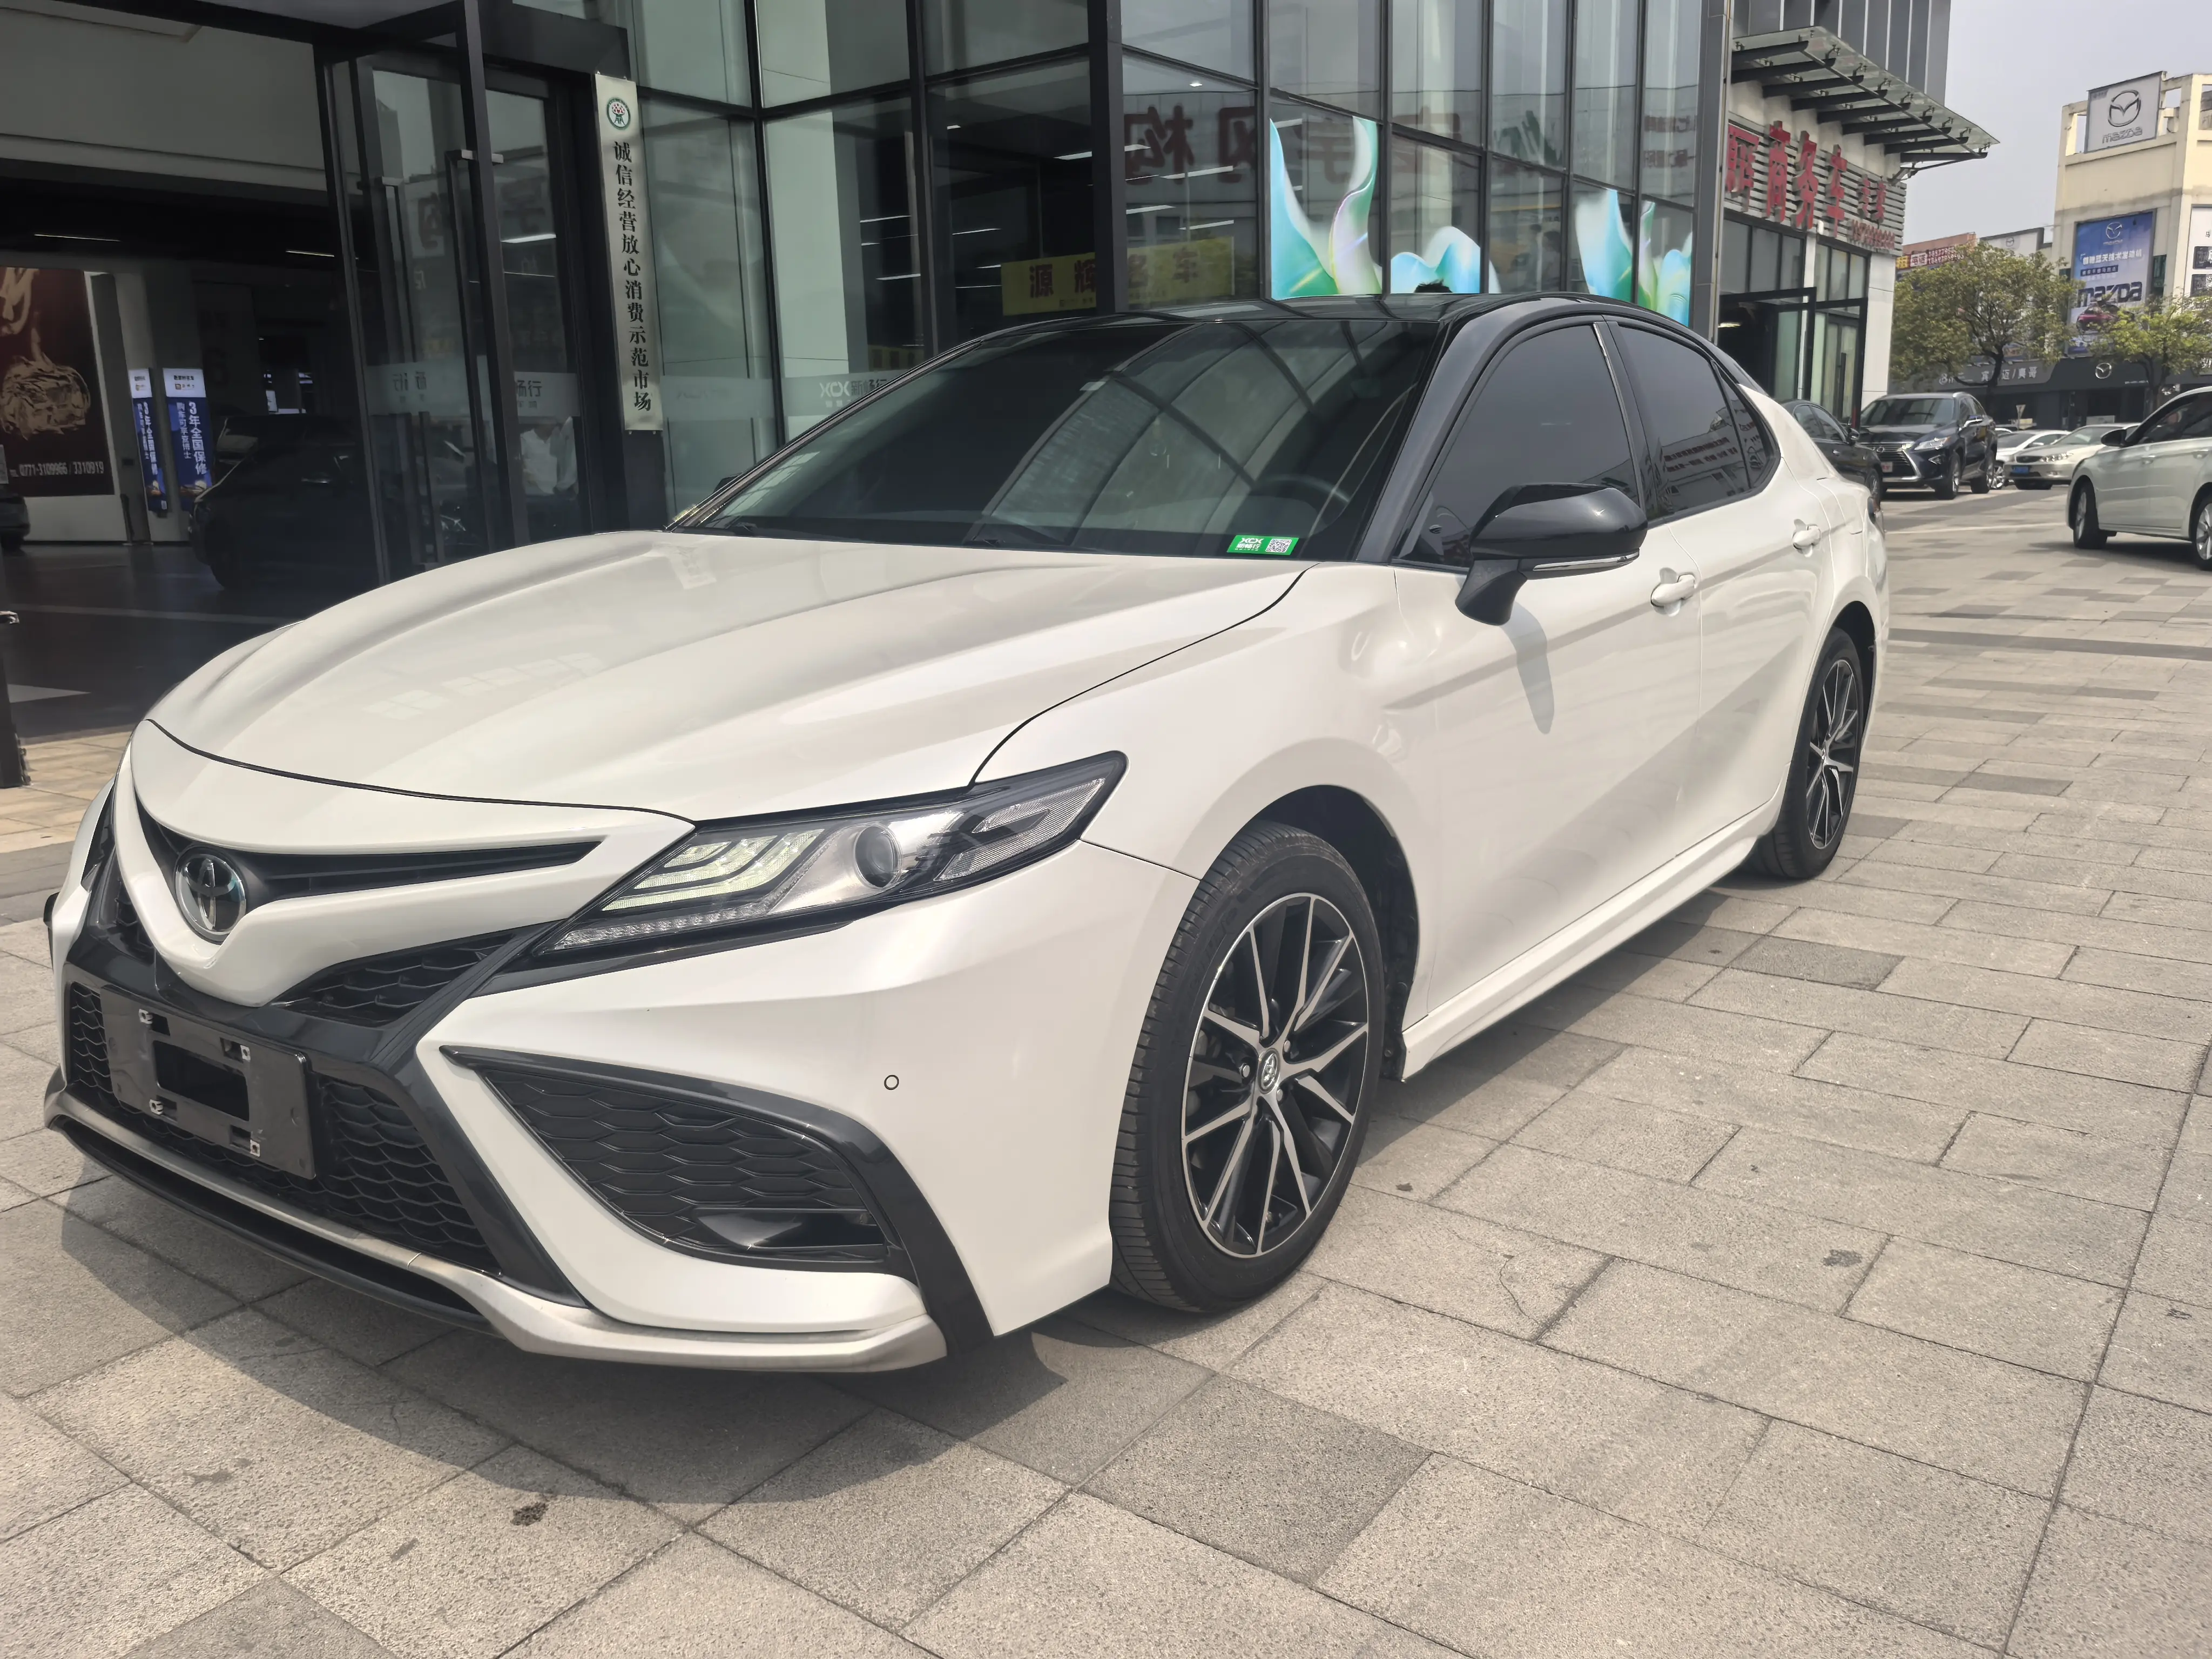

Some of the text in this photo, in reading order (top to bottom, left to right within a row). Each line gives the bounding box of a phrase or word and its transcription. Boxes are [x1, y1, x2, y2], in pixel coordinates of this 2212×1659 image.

[2102, 126, 2143, 144] mazda
[612, 140, 652, 412] 诚信经营放心消费示范市场
[2076, 281, 2143, 308] mazda
[188, 401, 207, 475] 3年全国保修
